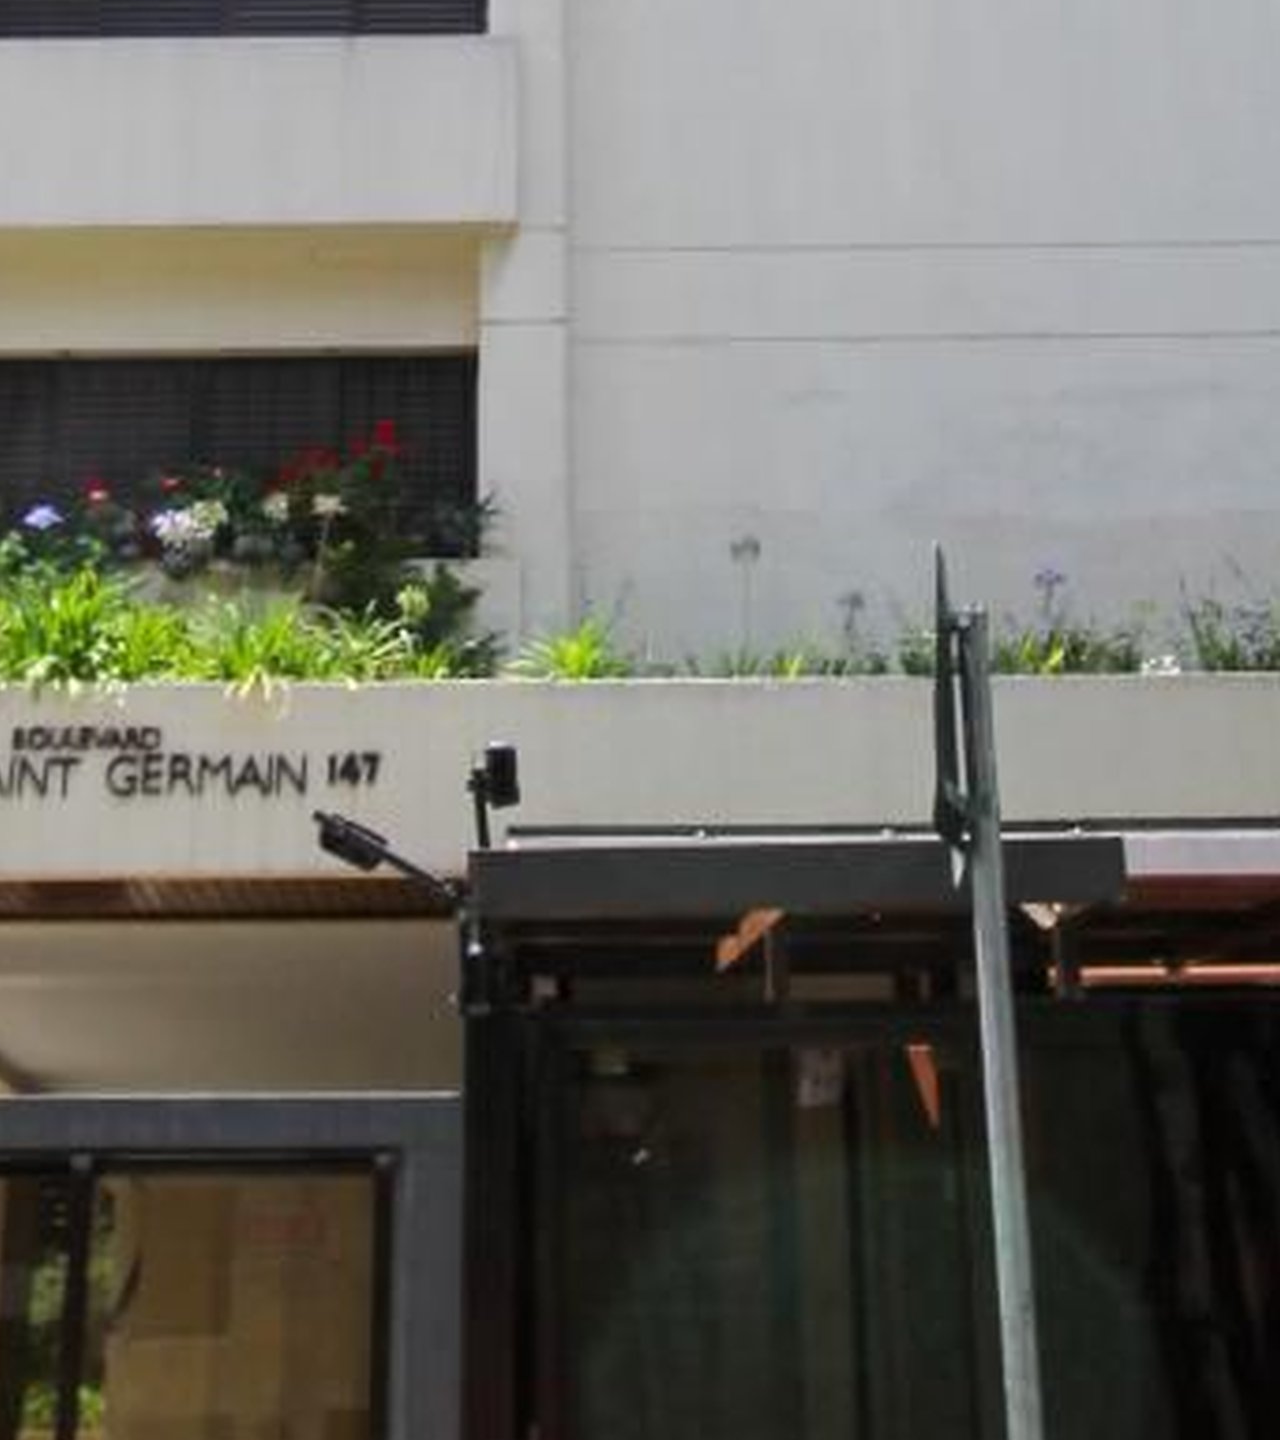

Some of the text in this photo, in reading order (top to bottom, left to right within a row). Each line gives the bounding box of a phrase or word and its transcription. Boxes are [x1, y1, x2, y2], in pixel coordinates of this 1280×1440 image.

[13, 727, 161, 751] BOULEVARD
[106, 751, 308, 798] GERMAIN
[327, 751, 382, 787] 147
